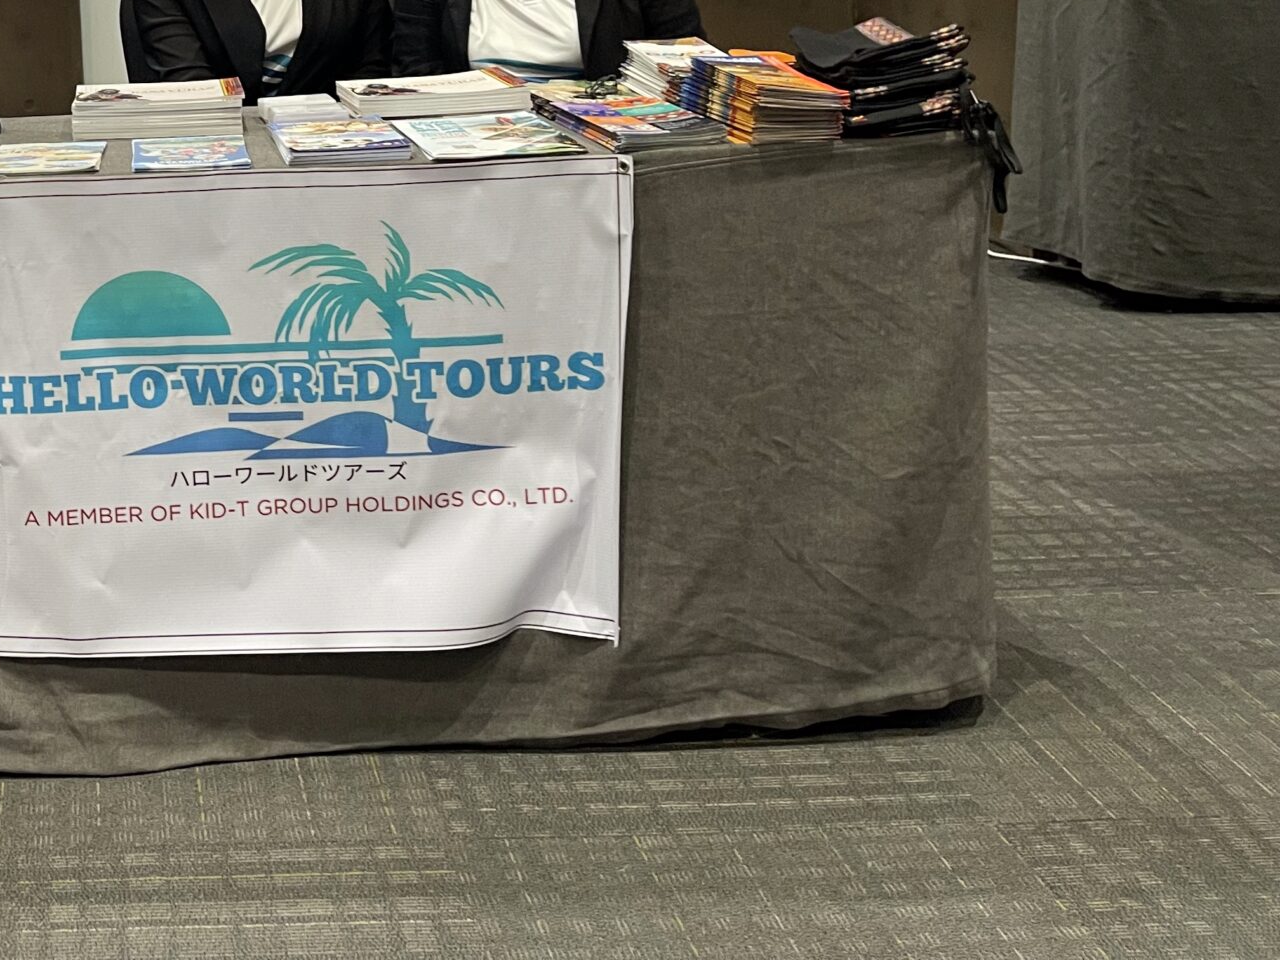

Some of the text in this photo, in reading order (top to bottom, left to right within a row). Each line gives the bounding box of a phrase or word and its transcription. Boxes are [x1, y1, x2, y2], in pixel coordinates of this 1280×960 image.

[180, 363, 393, 407] WORLD
[406, 351, 605, 400] TOURS
[170, 461, 408, 488] ハローワールドツアーズ
[24, 487, 573, 528] A MEMBER OF KID-T GROUP HOLDINGS CO., LTD.
